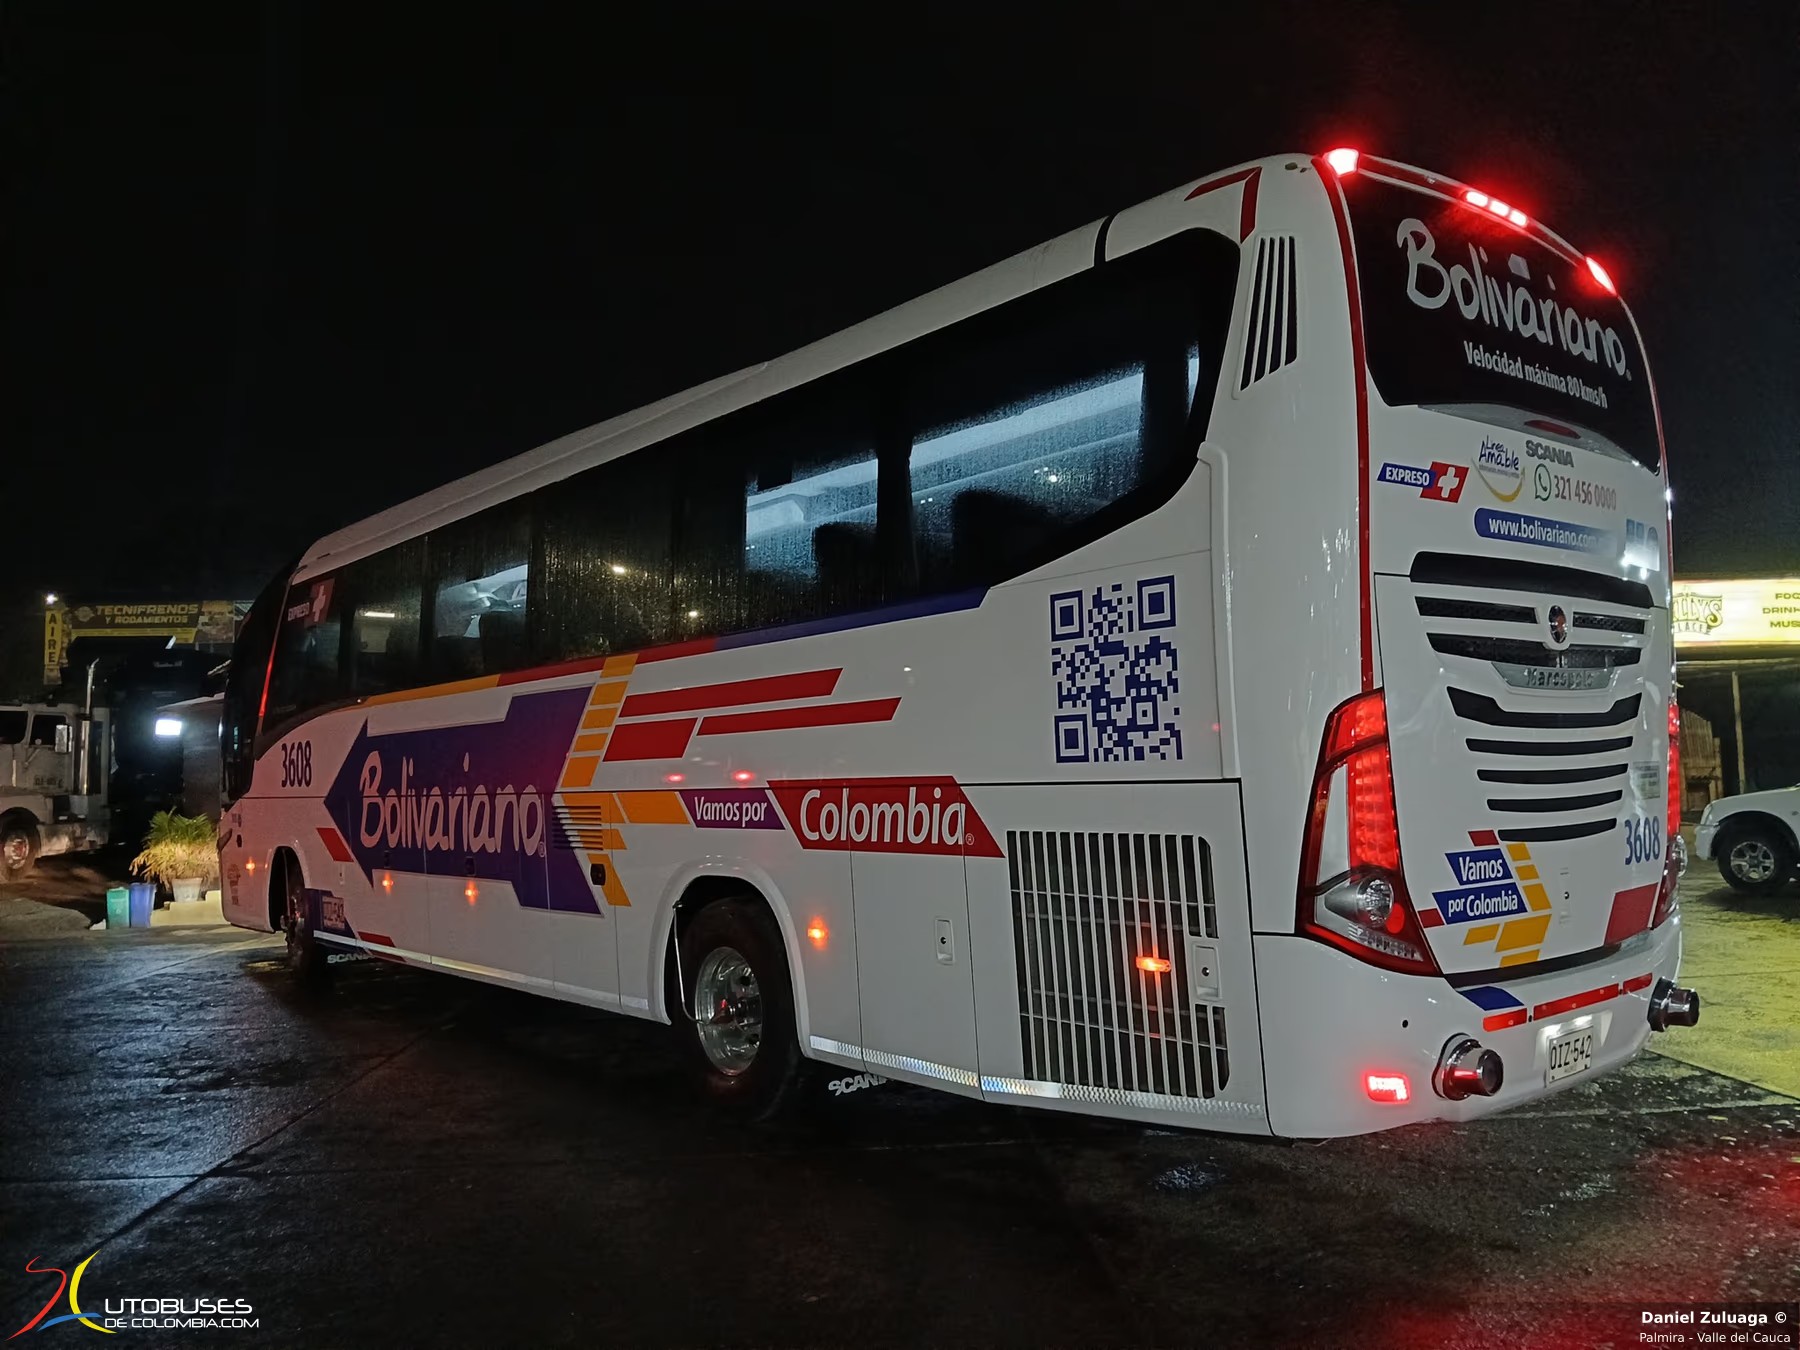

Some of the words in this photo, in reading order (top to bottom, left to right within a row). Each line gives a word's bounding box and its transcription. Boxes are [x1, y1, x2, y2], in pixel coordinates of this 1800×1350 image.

[1397, 218, 1627, 376] Bolivariano
[1464, 340, 1523, 379] Velocidad
[1525, 363, 1566, 393] máxima
[1567, 375, 1580, 398] 80
[1479, 440, 1519, 470] Amable
[1526, 440, 1574, 468] SCANIA
[1386, 467, 1430, 487] EXPRESO
[1554, 475, 1572, 501] 321
[1575, 480, 1593, 505] 456
[1595, 485, 1617, 511] 0000
[95, 603, 199, 616] TECNIFRENOS
[105, 616, 111, 625] Y
[114, 615, 189, 625] RODAMIENTOS
[47, 613, 57, 663] AIRE
[281, 740, 312, 788] 3608
[360, 751, 544, 857] Bolivariano
[694, 796, 740, 822] Vamos
[742, 799, 768, 828] por
[800, 786, 966, 846] Colombia
[1624, 816, 1661, 866] 3608
[1458, 857, 1503, 882] Vamos
[1448, 897, 1465, 918] por
[1466, 891, 1517, 917] Colombia
[828, 1073, 887, 1096] SCAN
